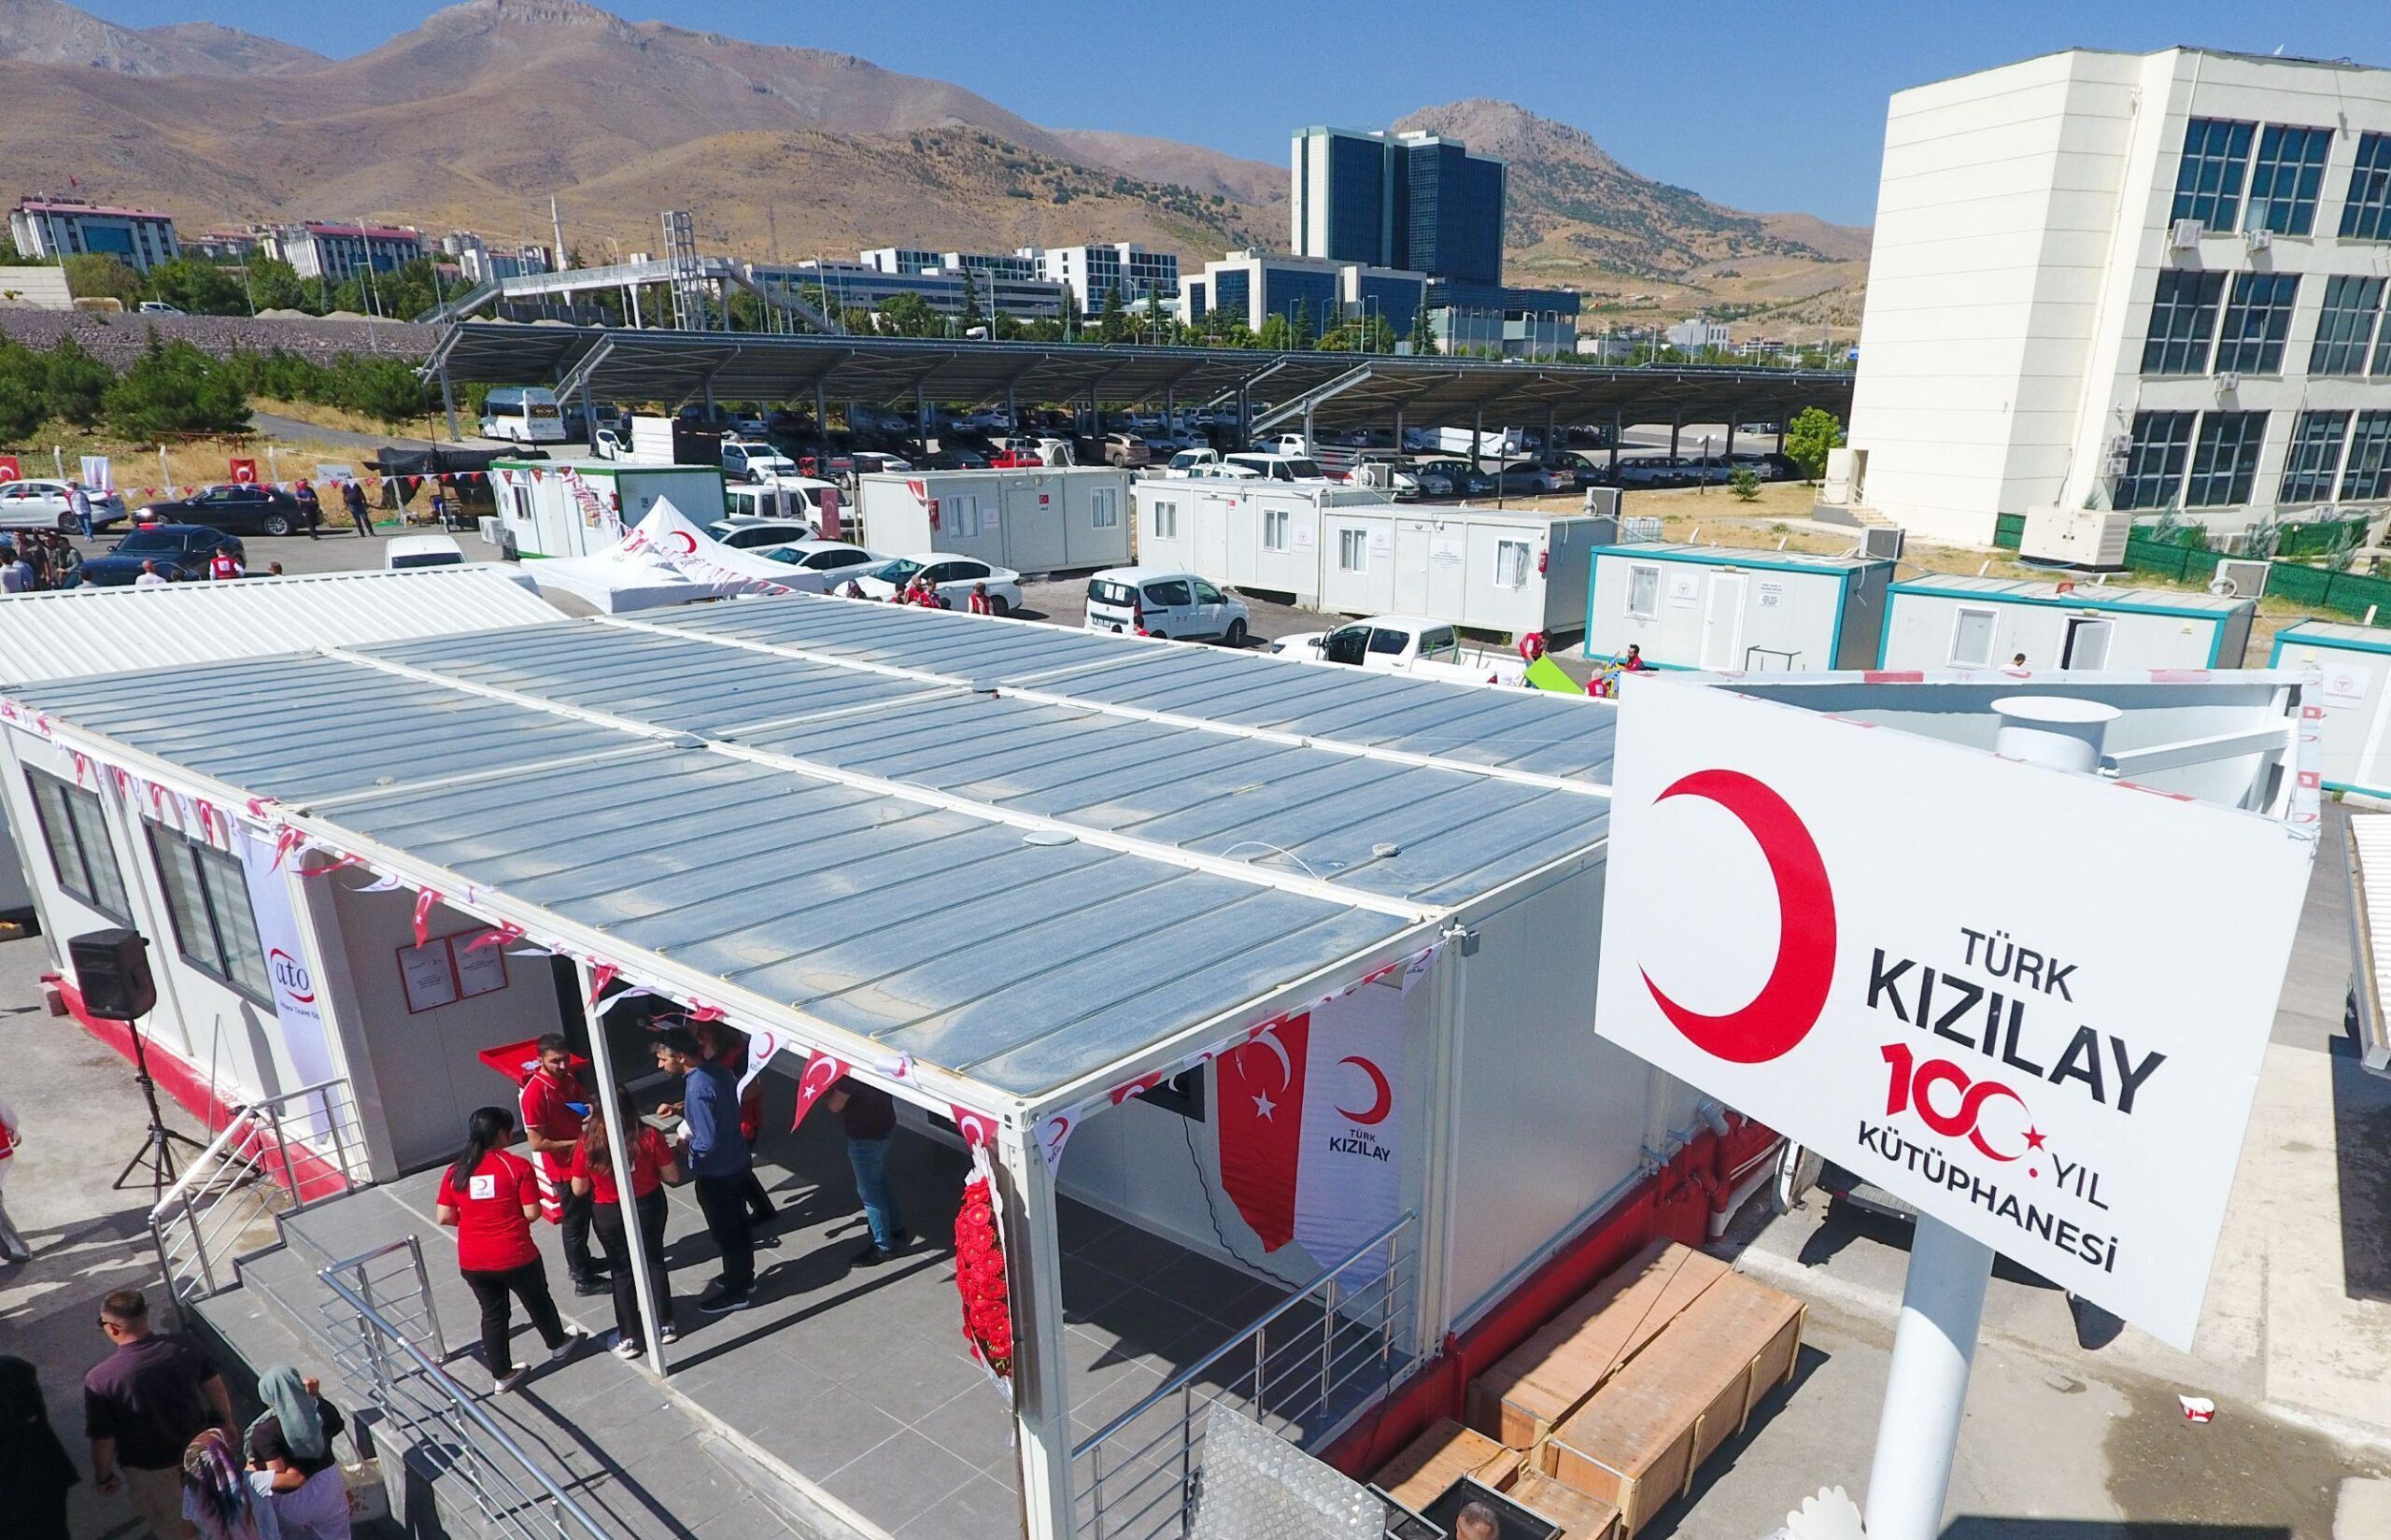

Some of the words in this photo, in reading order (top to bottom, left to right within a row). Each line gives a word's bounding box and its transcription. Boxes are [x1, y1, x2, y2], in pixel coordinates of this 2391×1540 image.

[276, 961, 309, 990] ato
[1960, 926, 2079, 1002] TÜRK
[1867, 947, 2168, 1116] KIZILAY
[1330, 1137, 1390, 1162] KIZILAY
[1350, 1129, 1376, 1142] TÜRK
[1858, 1120, 2119, 1274] KÜTÜPHANESİ
[2052, 1152, 2110, 1211] YIL
